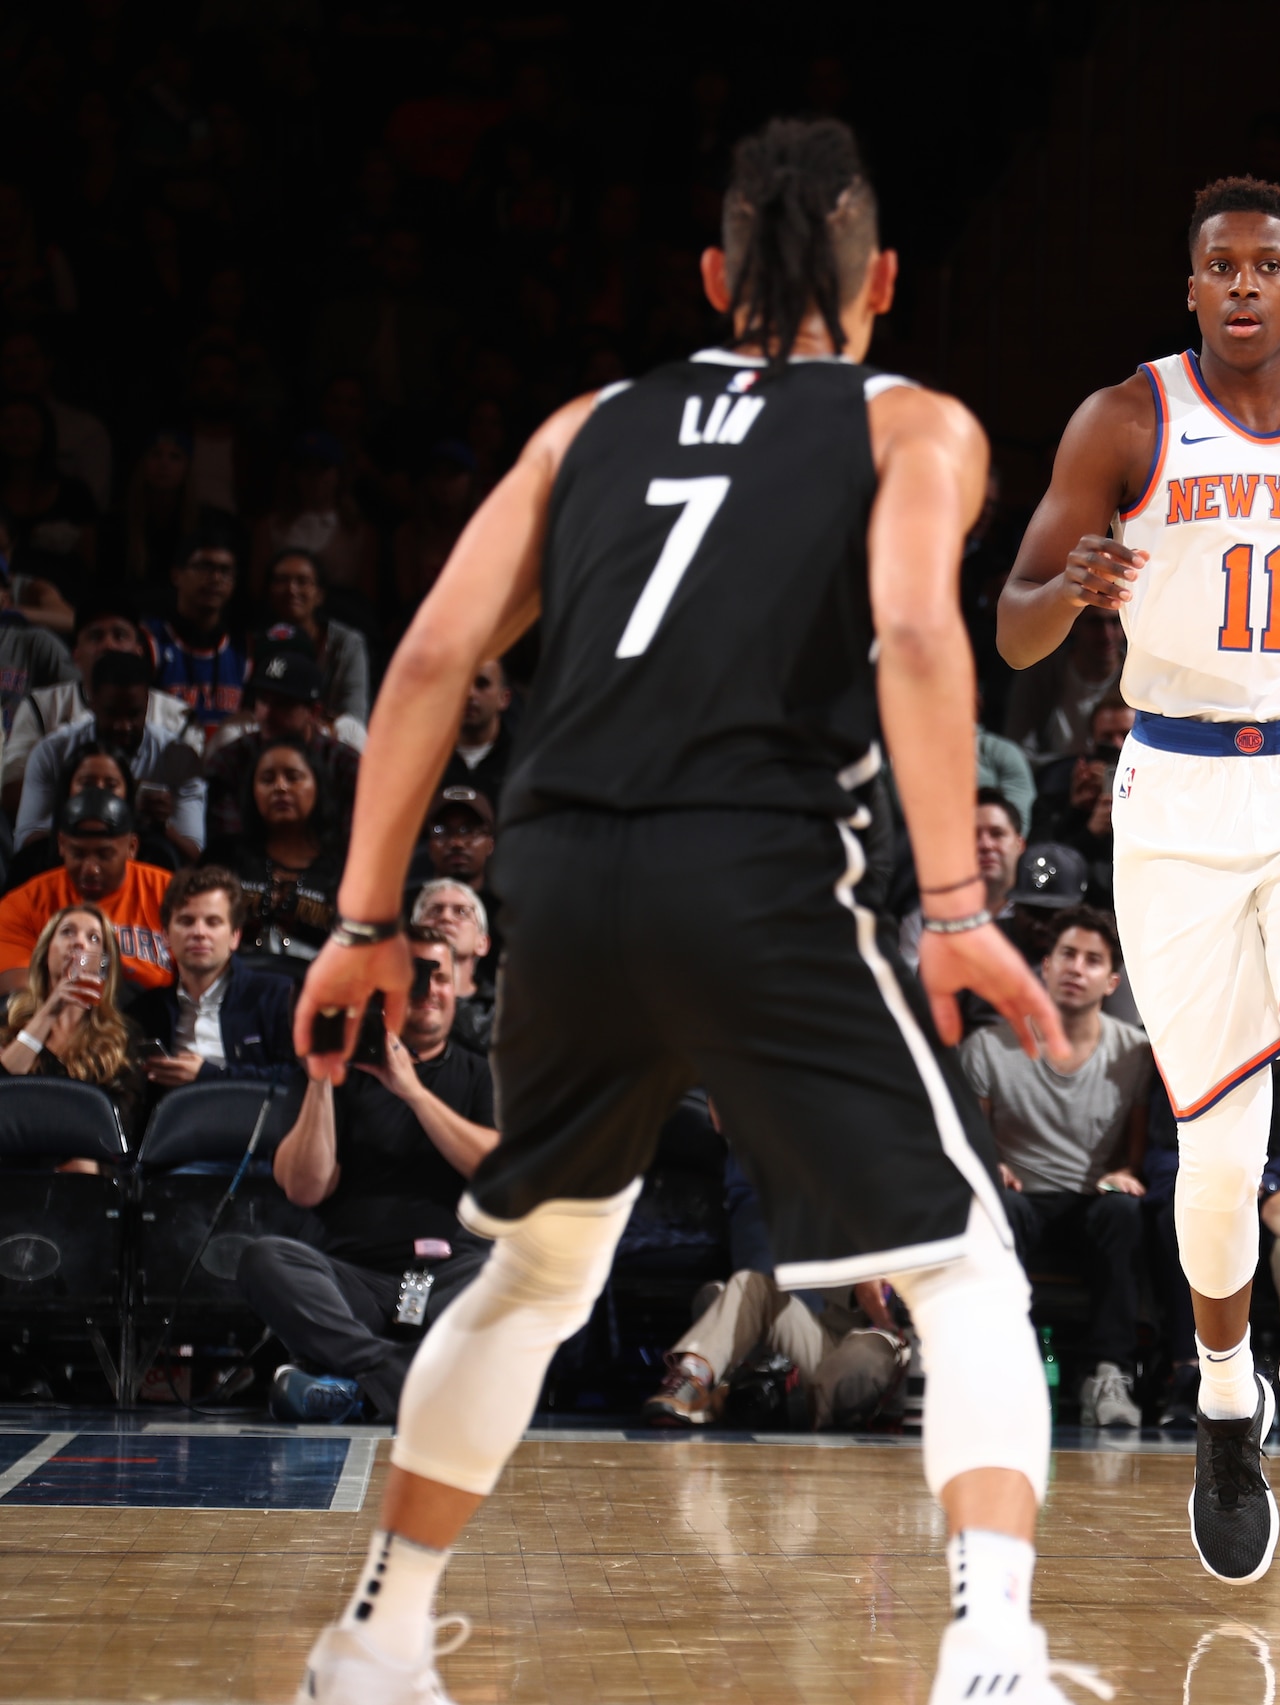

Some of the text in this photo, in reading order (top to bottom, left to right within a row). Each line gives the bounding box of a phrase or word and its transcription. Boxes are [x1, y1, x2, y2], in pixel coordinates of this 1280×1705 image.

[678, 394, 766, 446] LIN
[1165, 474, 1261, 527] NEW
[615, 475, 731, 659] 7
[113, 924, 174, 973] ORK
